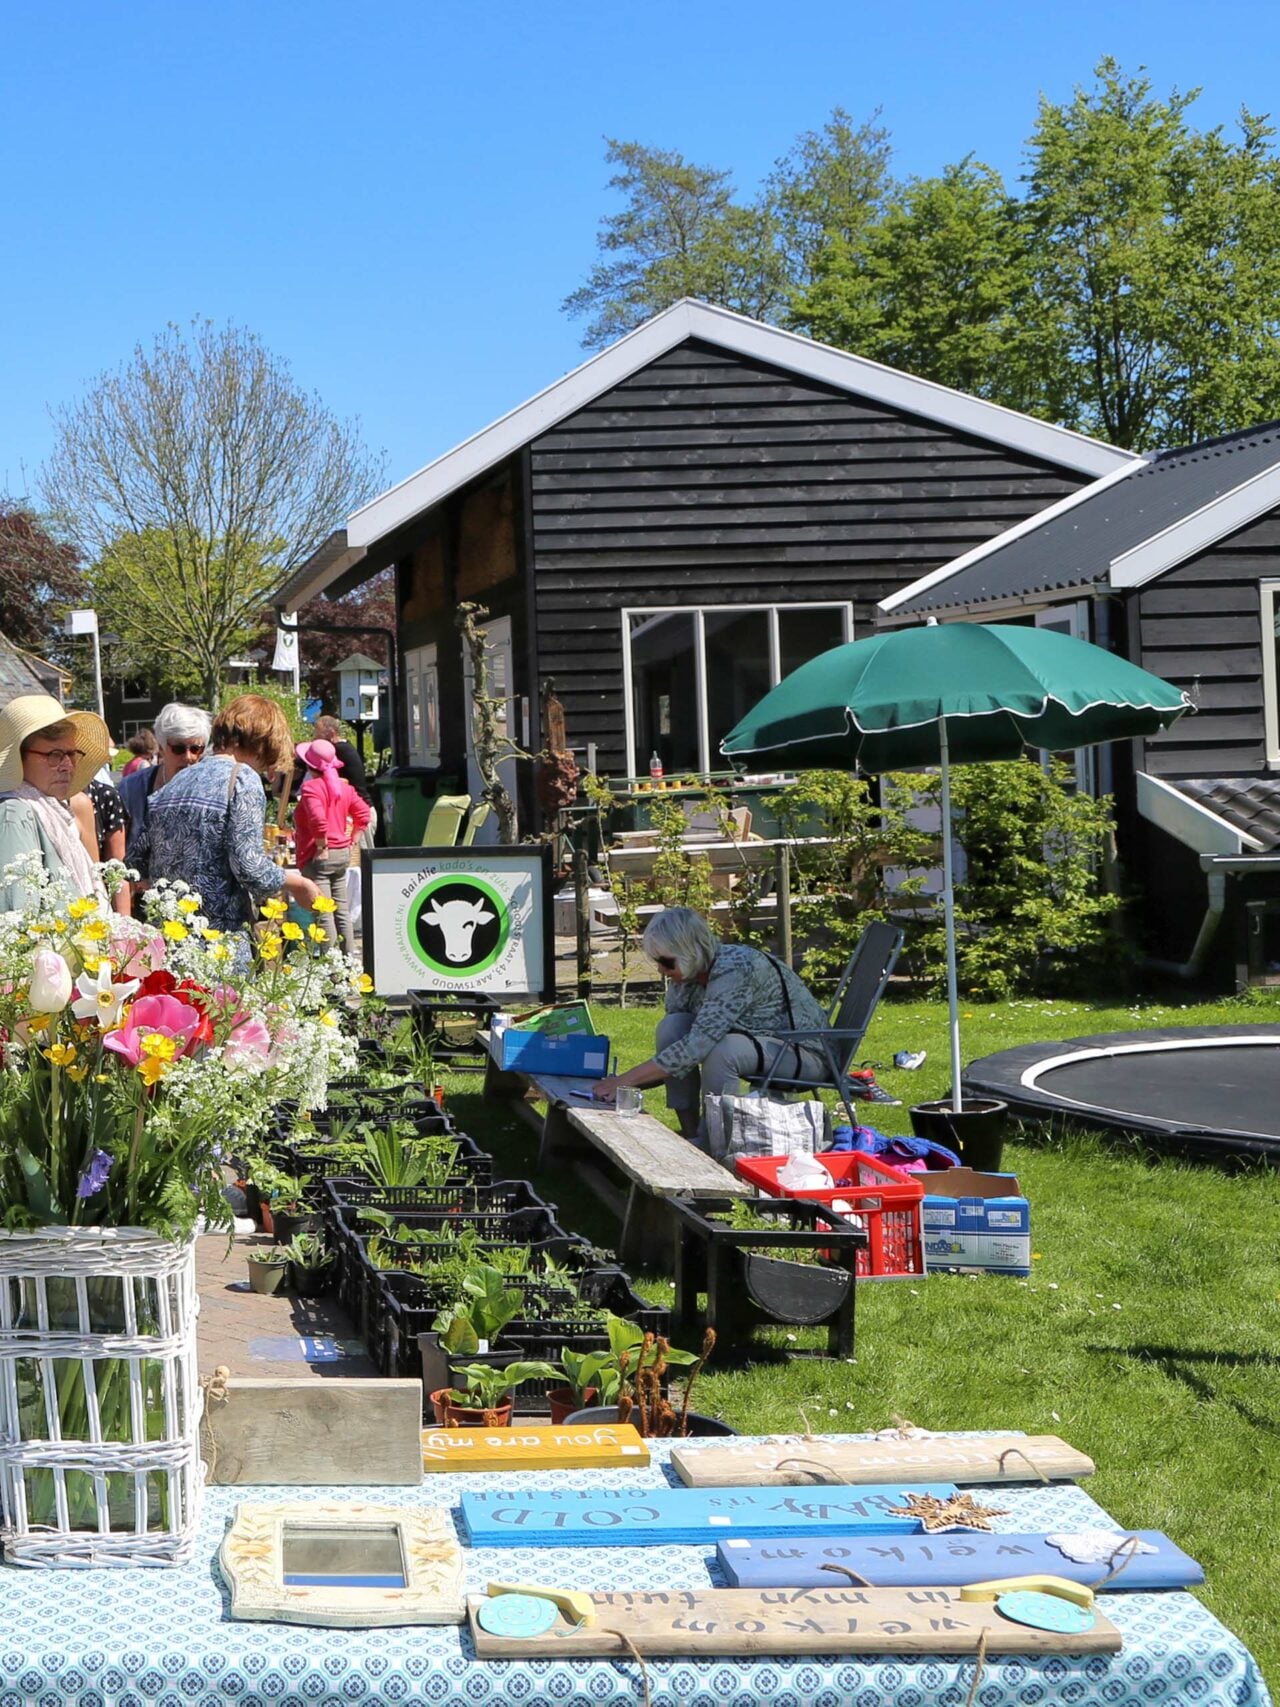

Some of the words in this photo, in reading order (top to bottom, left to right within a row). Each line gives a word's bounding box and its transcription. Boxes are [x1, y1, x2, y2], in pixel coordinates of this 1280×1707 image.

[401, 878, 418, 899] Bai
[417, 866, 437, 882] Alie
[489, 873, 510, 893] zuks
[491, 963, 507, 976] 43,
[431, 974, 493, 990] AARTSWOUD
[427, 1433, 474, 1447] my
[484, 1435, 541, 1447] are
[555, 1428, 619, 1445] you
[472, 1489, 648, 1501] OUTSIDE
[765, 1494, 898, 1520] BABY
[491, 1506, 661, 1528] COLD
[759, 1544, 1035, 1562] welkom
[591, 1591, 704, 1611] tuin
[759, 1587, 872, 1605] myn
[904, 1590, 953, 1609] in
[671, 1617, 972, 1636] welkom
